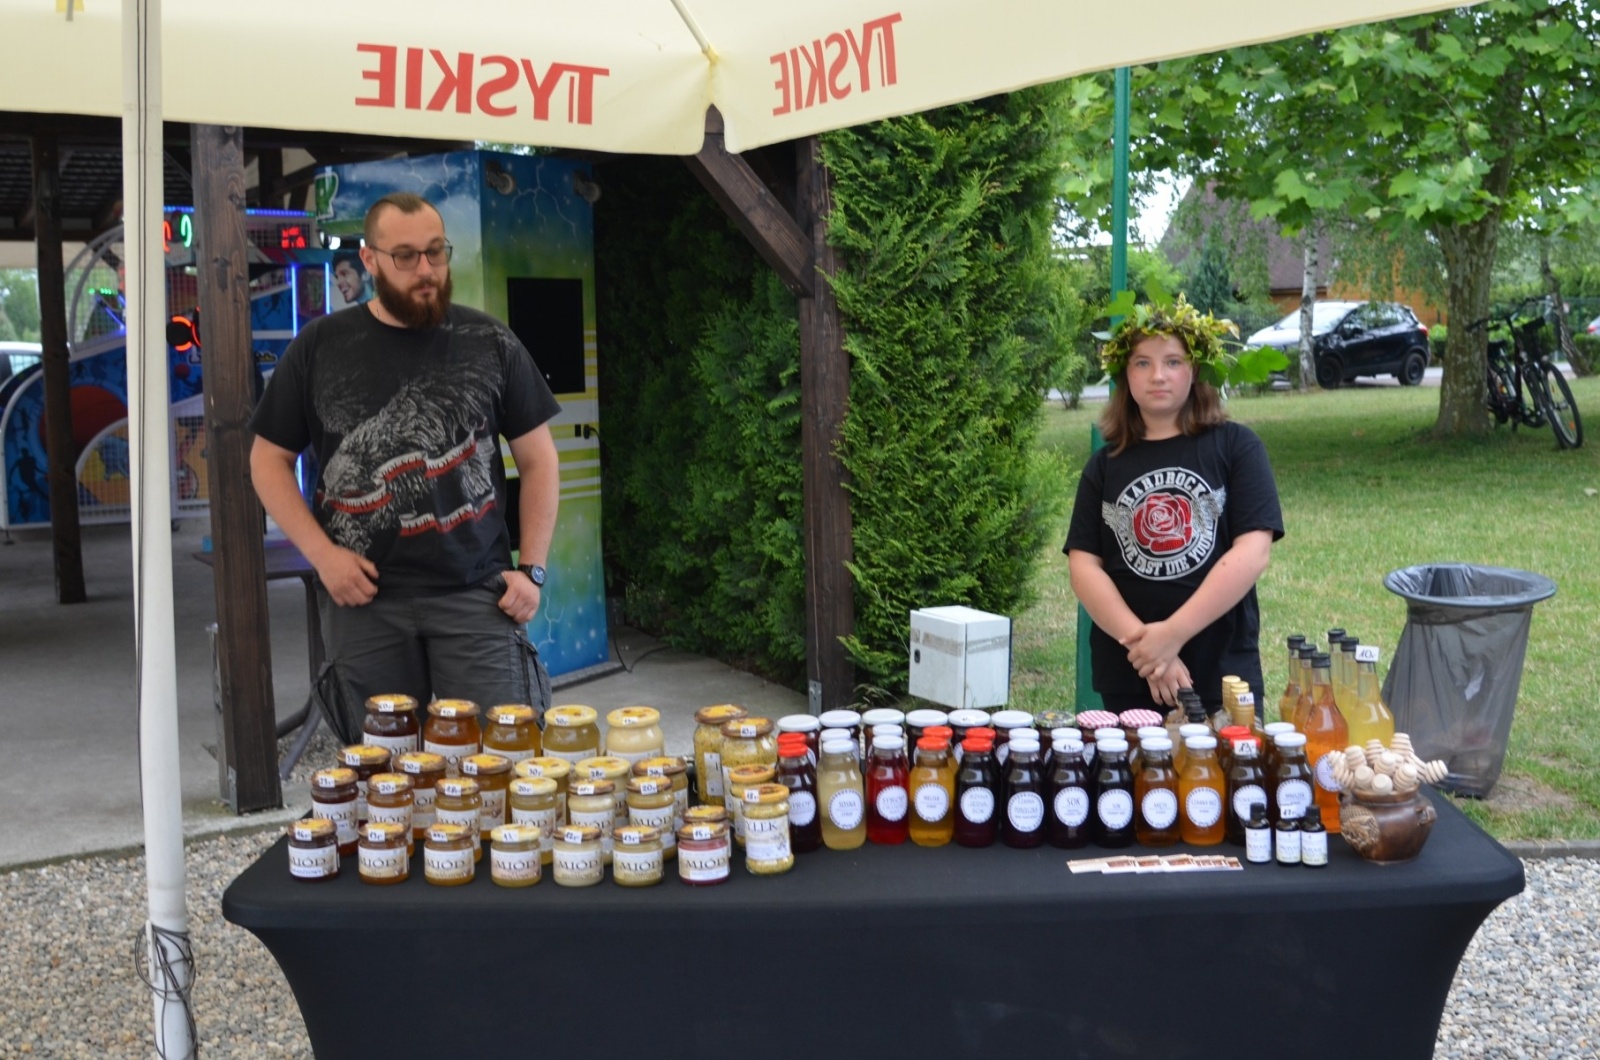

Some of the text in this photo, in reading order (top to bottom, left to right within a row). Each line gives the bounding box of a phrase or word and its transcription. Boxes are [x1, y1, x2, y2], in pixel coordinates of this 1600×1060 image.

[1121, 471, 1206, 508] HARDROCK
[1133, 556, 1163, 576] FAST
[1164, 556, 1190, 576] DIE
[496, 859, 536, 871] MIÓD
[559, 859, 598, 871] MIÓD
